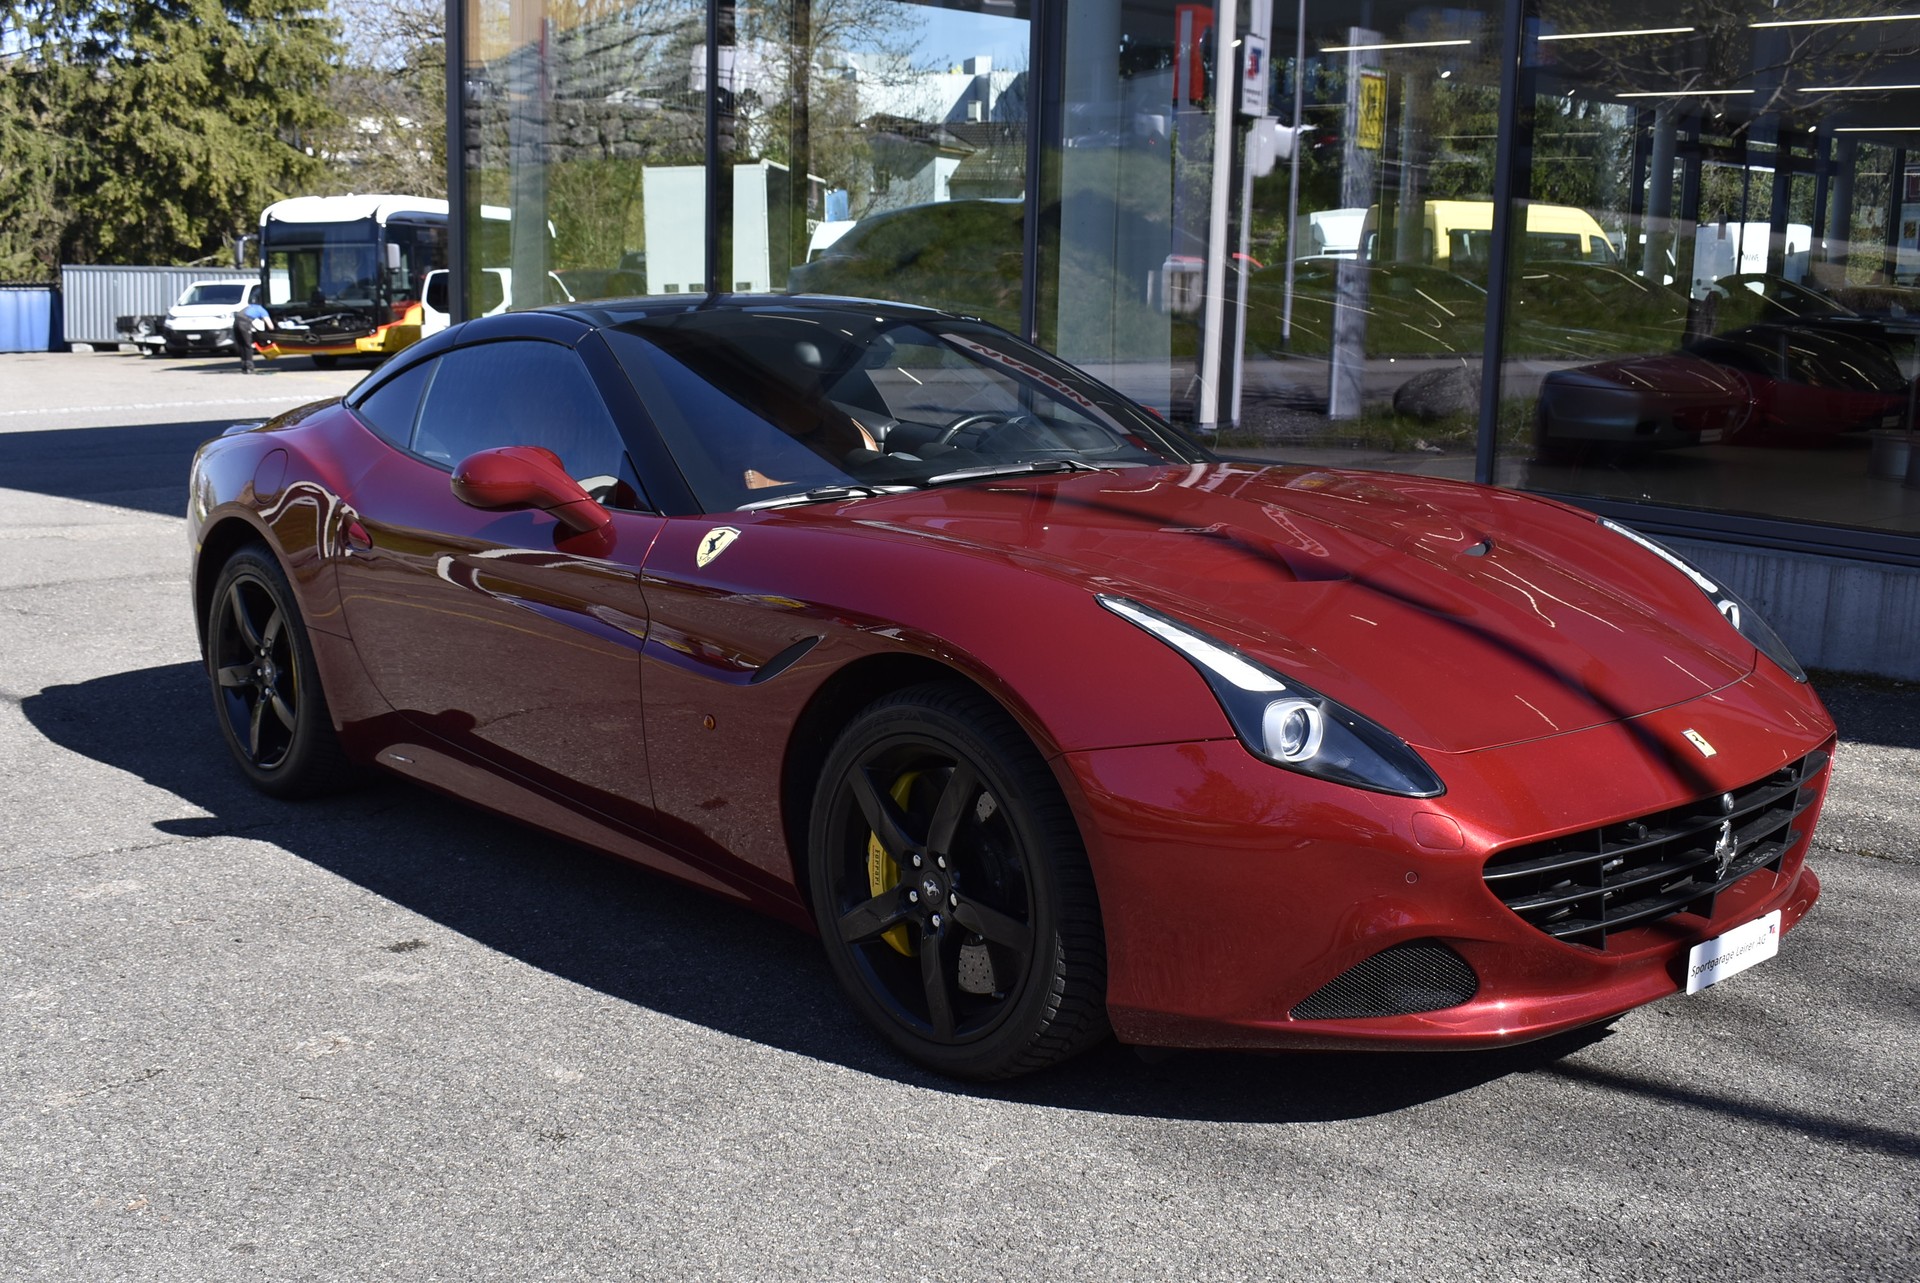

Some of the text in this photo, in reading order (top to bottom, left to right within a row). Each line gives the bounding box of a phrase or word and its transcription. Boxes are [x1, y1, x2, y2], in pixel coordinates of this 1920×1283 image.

[969, 344, 1092, 406] NISSAN
[1691, 950, 1735, 978] Sportgarage
[1757, 933, 1767, 946] AG
